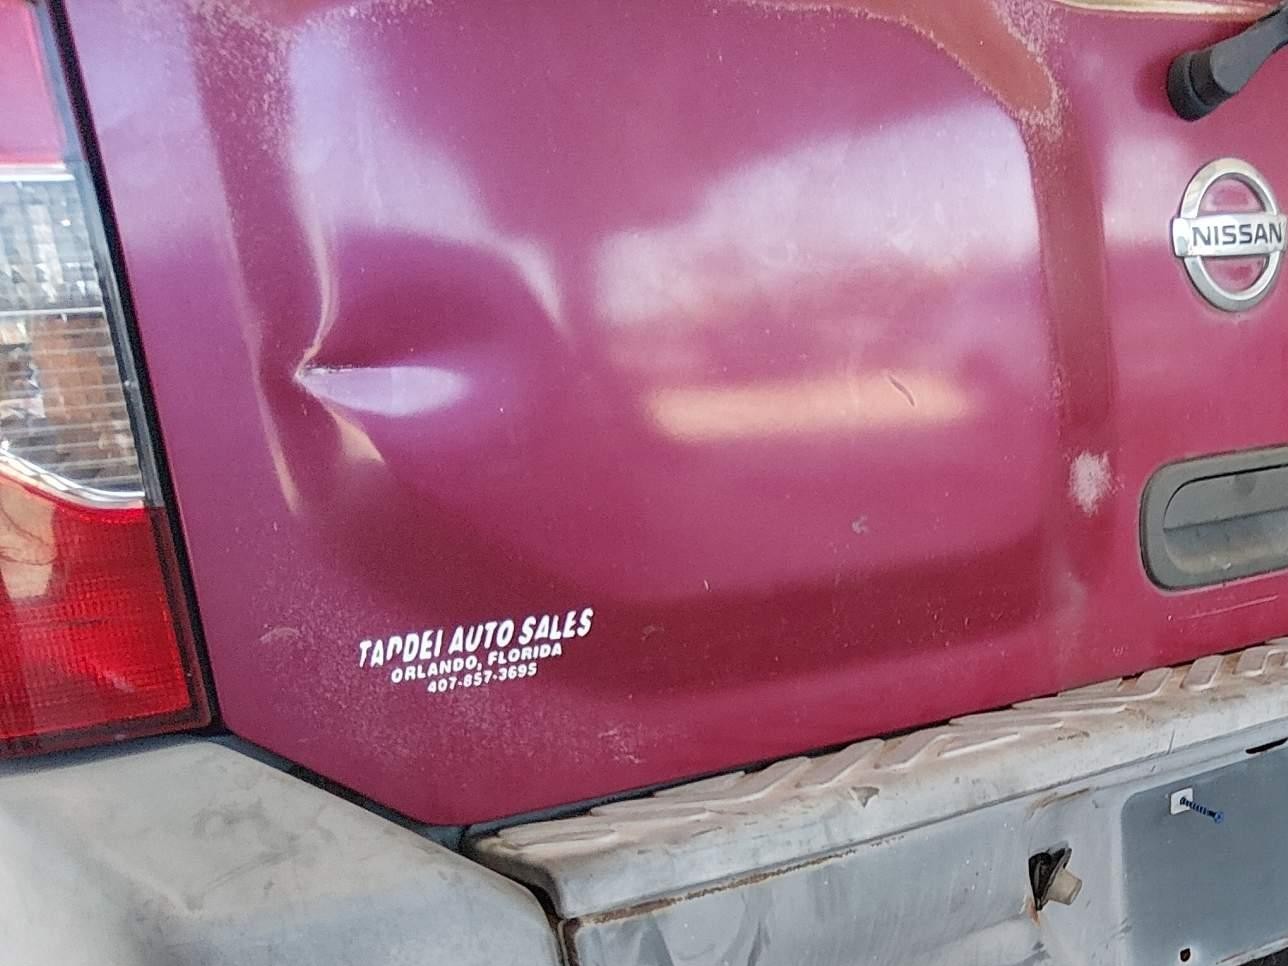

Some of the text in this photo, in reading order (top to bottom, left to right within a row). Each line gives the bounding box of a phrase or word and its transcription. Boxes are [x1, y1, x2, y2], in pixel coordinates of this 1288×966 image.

[1191, 222, 1282, 247] NISSAN
[448, 619, 515, 655] AUTO
[518, 607, 594, 645] SALES
[391, 642, 562, 684] ORLANDO, FLORIDA
[427, 662, 538, 693] 407-857-3695
